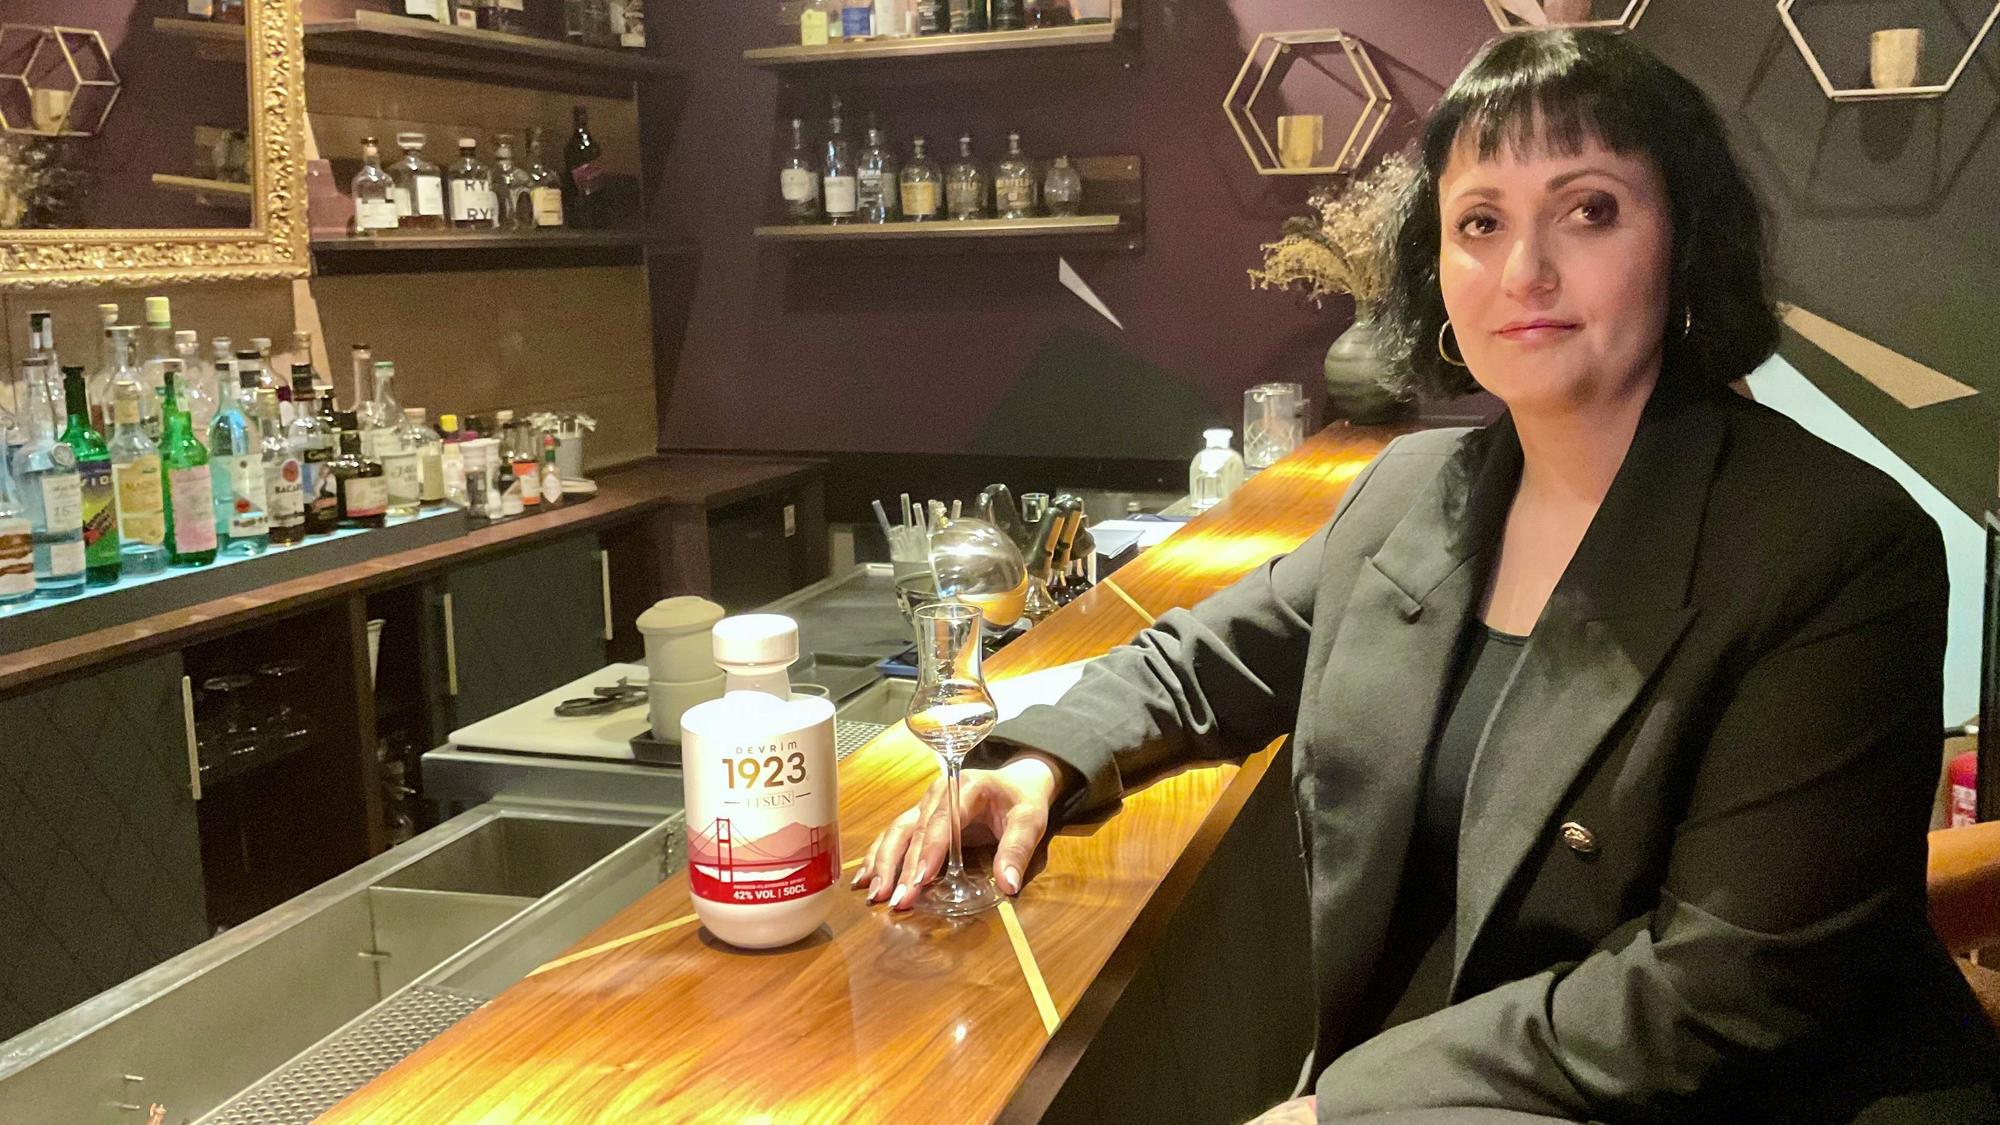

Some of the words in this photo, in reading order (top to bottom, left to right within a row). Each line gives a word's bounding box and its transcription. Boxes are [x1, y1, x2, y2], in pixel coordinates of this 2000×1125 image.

[721, 752, 806, 789] 1923
[733, 890, 754, 900] 42%
[755, 889, 776, 900] VOL
[783, 884, 807, 896] 50CL
